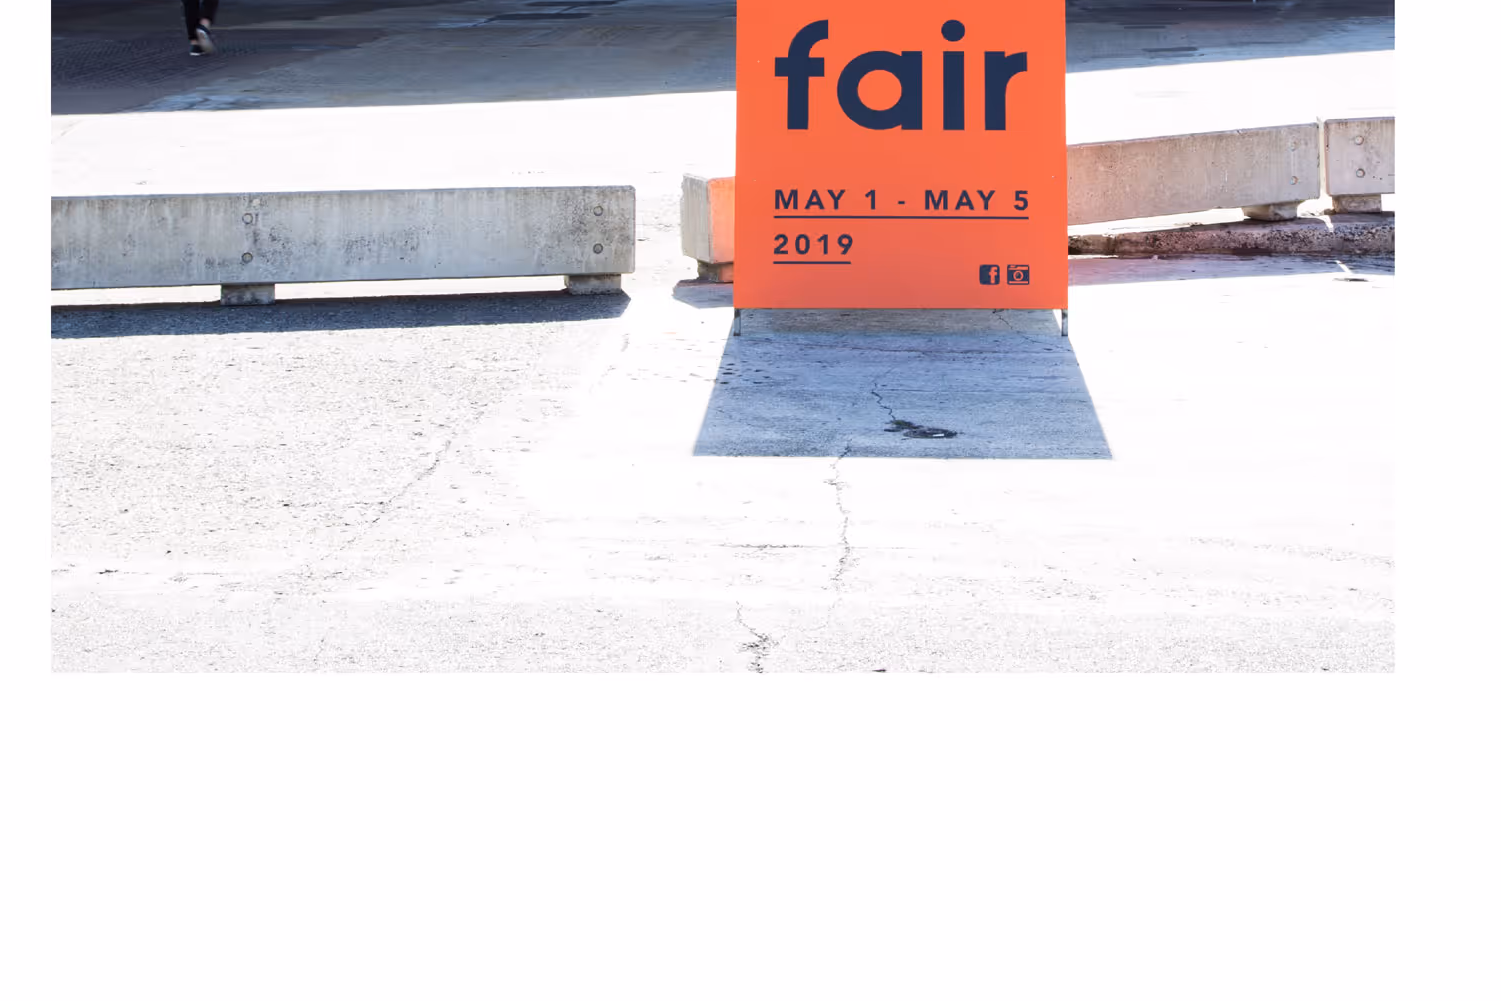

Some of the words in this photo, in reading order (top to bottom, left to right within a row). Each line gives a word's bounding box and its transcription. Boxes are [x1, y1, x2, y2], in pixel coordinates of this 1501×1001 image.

[774, 19, 1028, 131] fair
[774, 189, 847, 210] MAY
[864, 189, 877, 210] 1
[924, 190, 996, 211] MAY
[1013, 190, 1030, 211] 5
[773, 233, 854, 255] 2019
